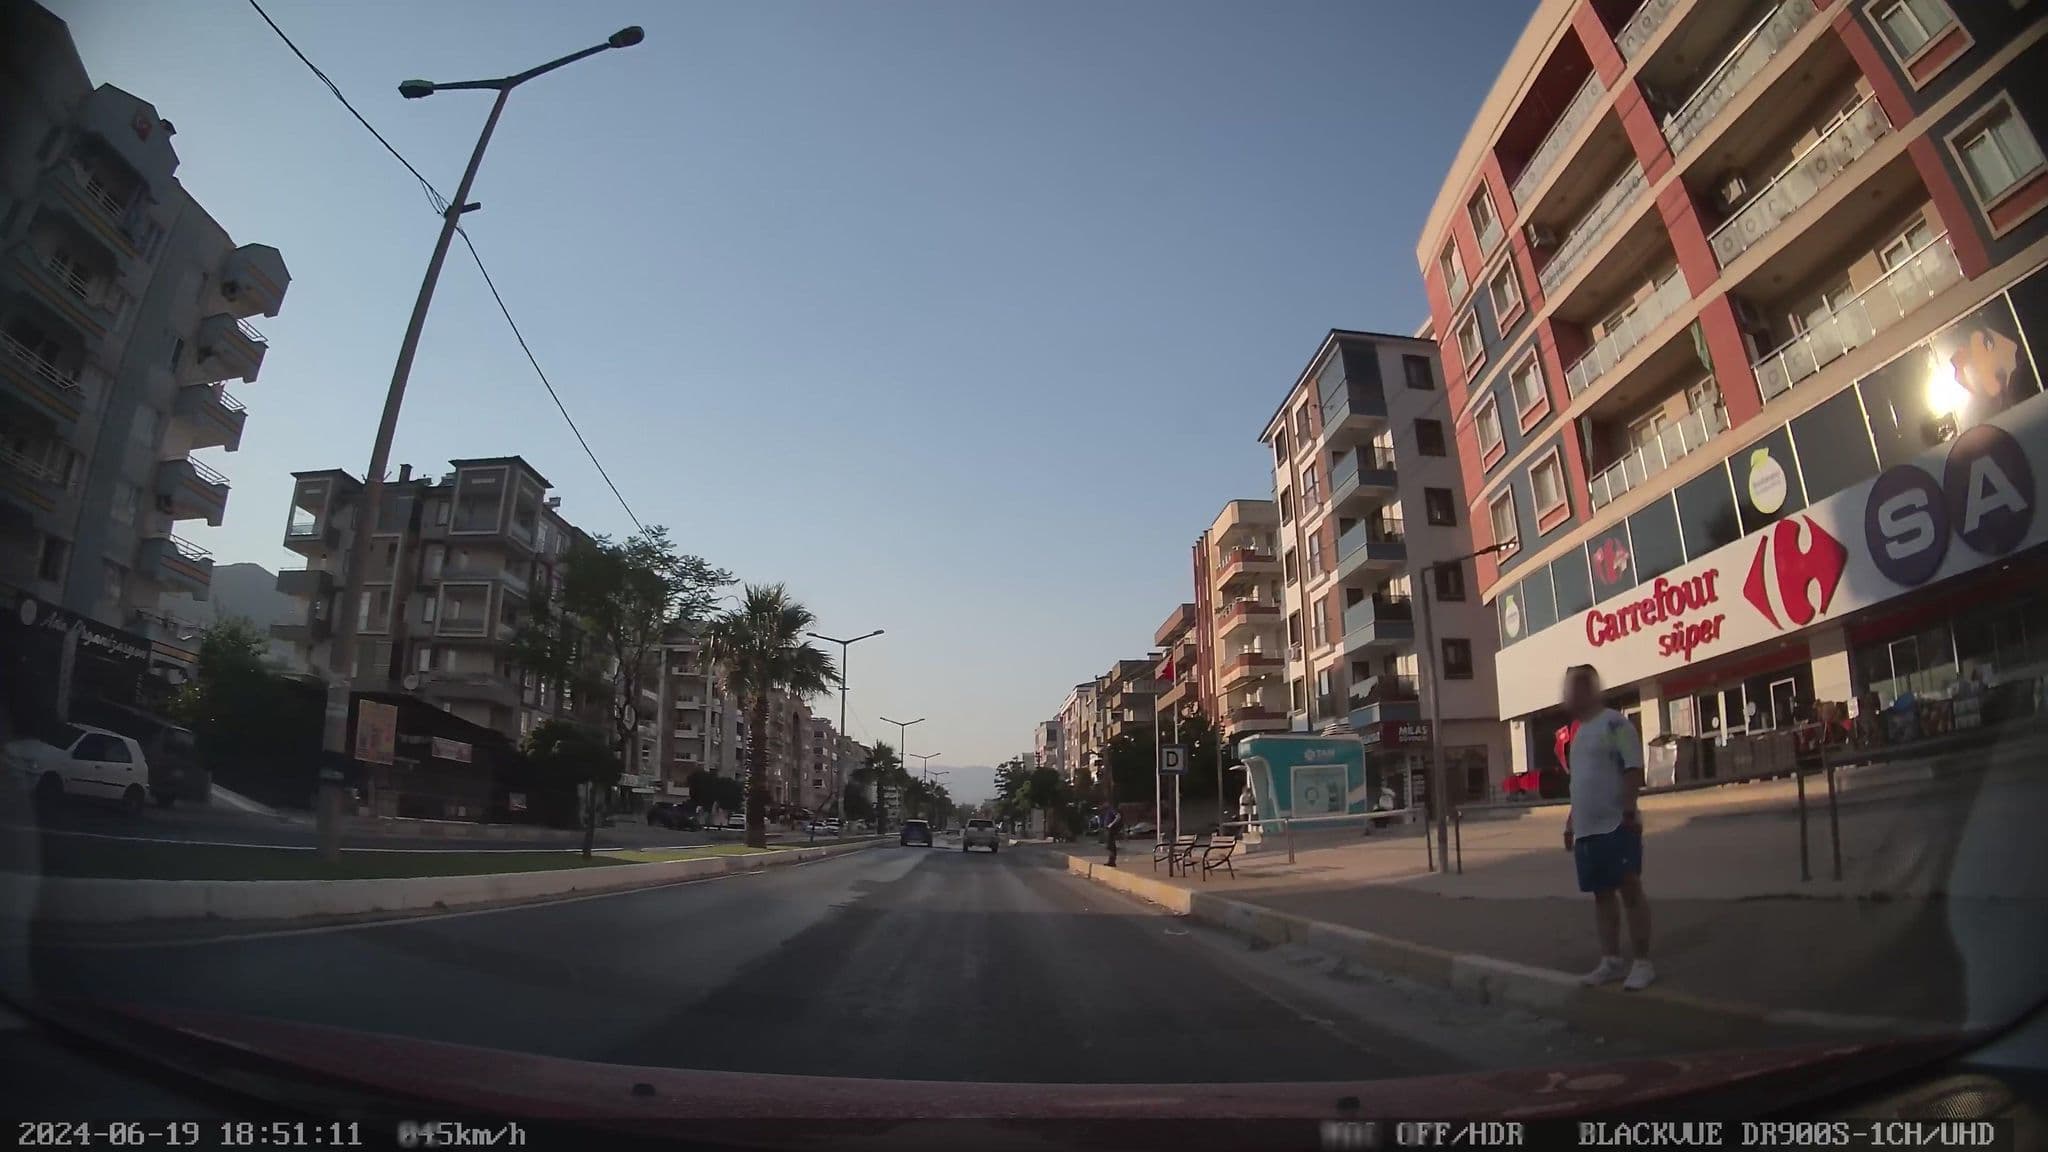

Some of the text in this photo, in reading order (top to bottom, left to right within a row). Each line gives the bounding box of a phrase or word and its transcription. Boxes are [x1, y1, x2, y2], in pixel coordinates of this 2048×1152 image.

[1586, 568, 1719, 647] Carrefour
[1658, 613, 1726, 662] süper
[1166, 751, 1179, 767] D
